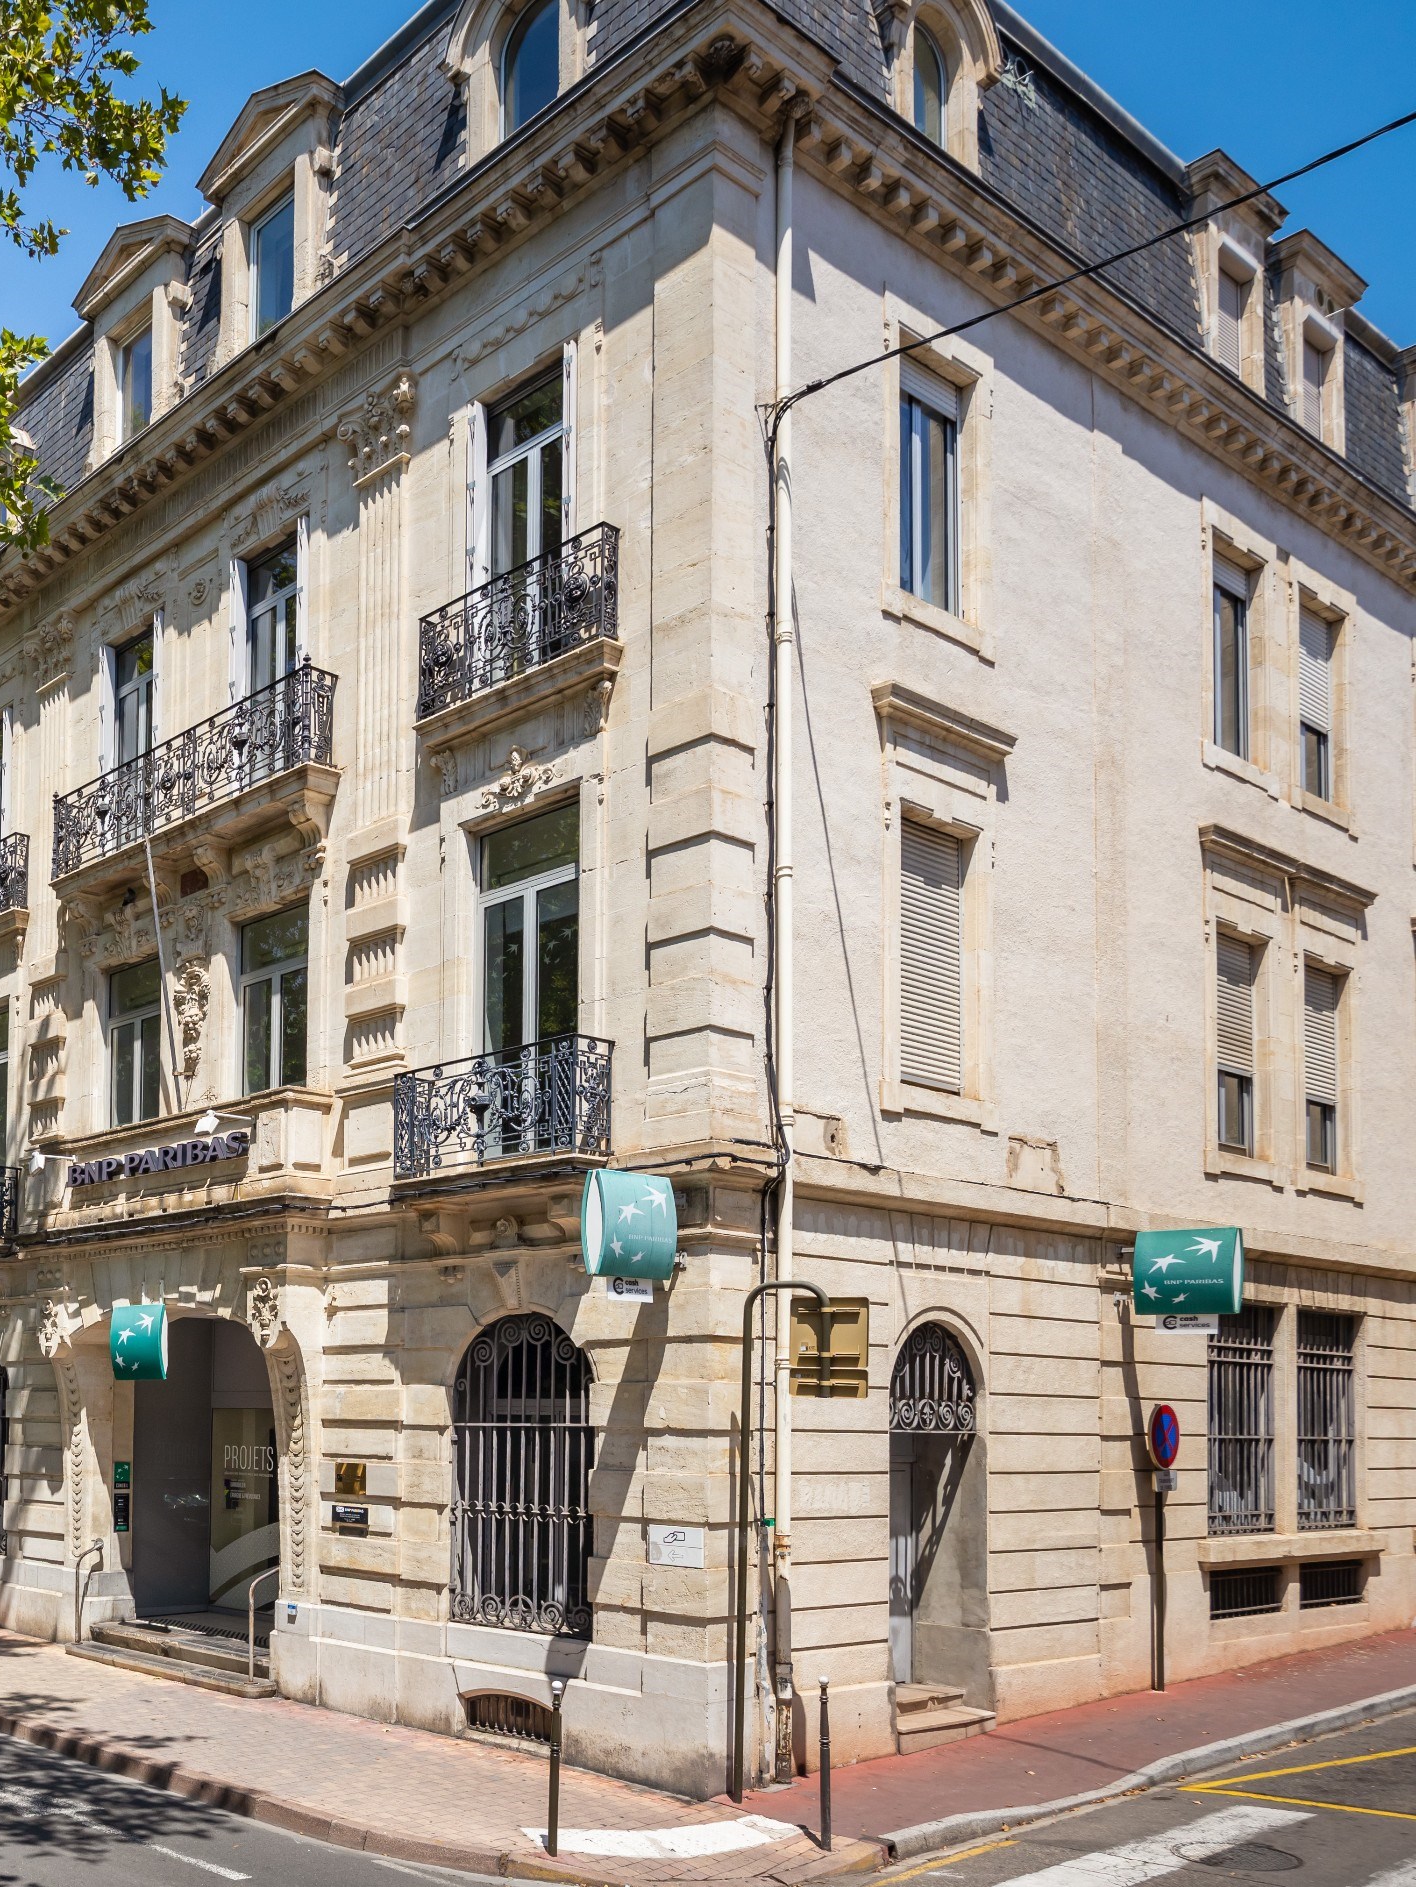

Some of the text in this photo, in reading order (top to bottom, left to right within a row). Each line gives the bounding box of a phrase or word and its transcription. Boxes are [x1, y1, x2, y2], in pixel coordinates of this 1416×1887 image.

[68, 1131, 248, 1187] BNP PARIBAS
[645, 1235, 672, 1243] PARIBAS
[625, 1287, 648, 1295] services
[224, 1445, 274, 1471] PROJETS
